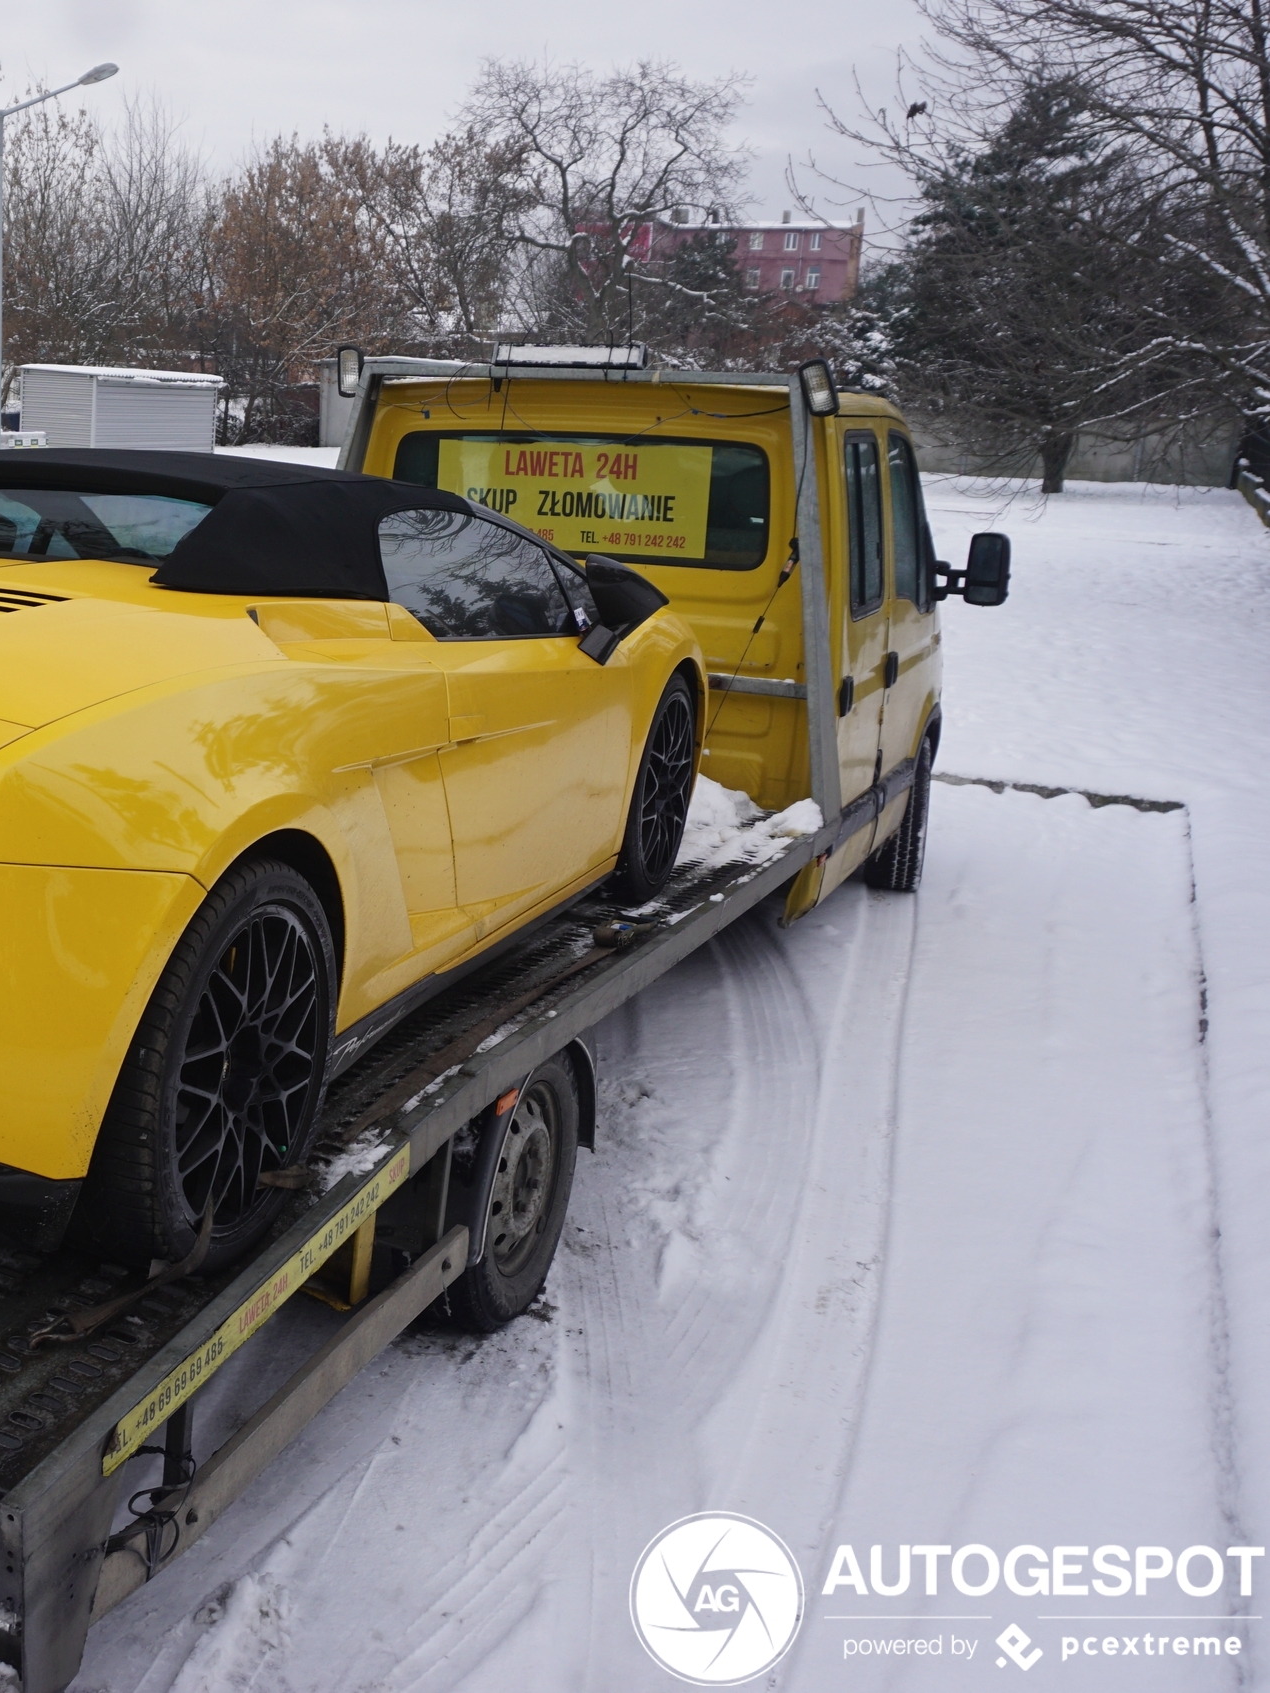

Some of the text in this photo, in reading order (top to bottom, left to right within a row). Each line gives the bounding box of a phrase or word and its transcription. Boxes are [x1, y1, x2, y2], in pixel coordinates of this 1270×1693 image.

[504, 449, 638, 480] LAWETA 24H
[536, 490, 676, 523] ZŁOMOWANIE
[580, 530, 686, 549] TEL. +48 791 242 242
[135, 1401, 156, 1430] +48
[158, 1386, 171, 1412] 69
[174, 1371, 187, 1397] 69
[190, 1356, 202, 1382] 69
[204, 1336, 224, 1366] 485
[239, 1291, 270, 1334] LAWETA
[273, 1273, 288, 1301] 24H
[300, 1249, 316, 1273] TEL.
[318, 1228, 333, 1252] +48
[335, 1213, 349, 1239] 791
[350, 1199, 365, 1225] 242
[366, 1182, 380, 1210] 242
[388, 1157, 405, 1185] SKUP
